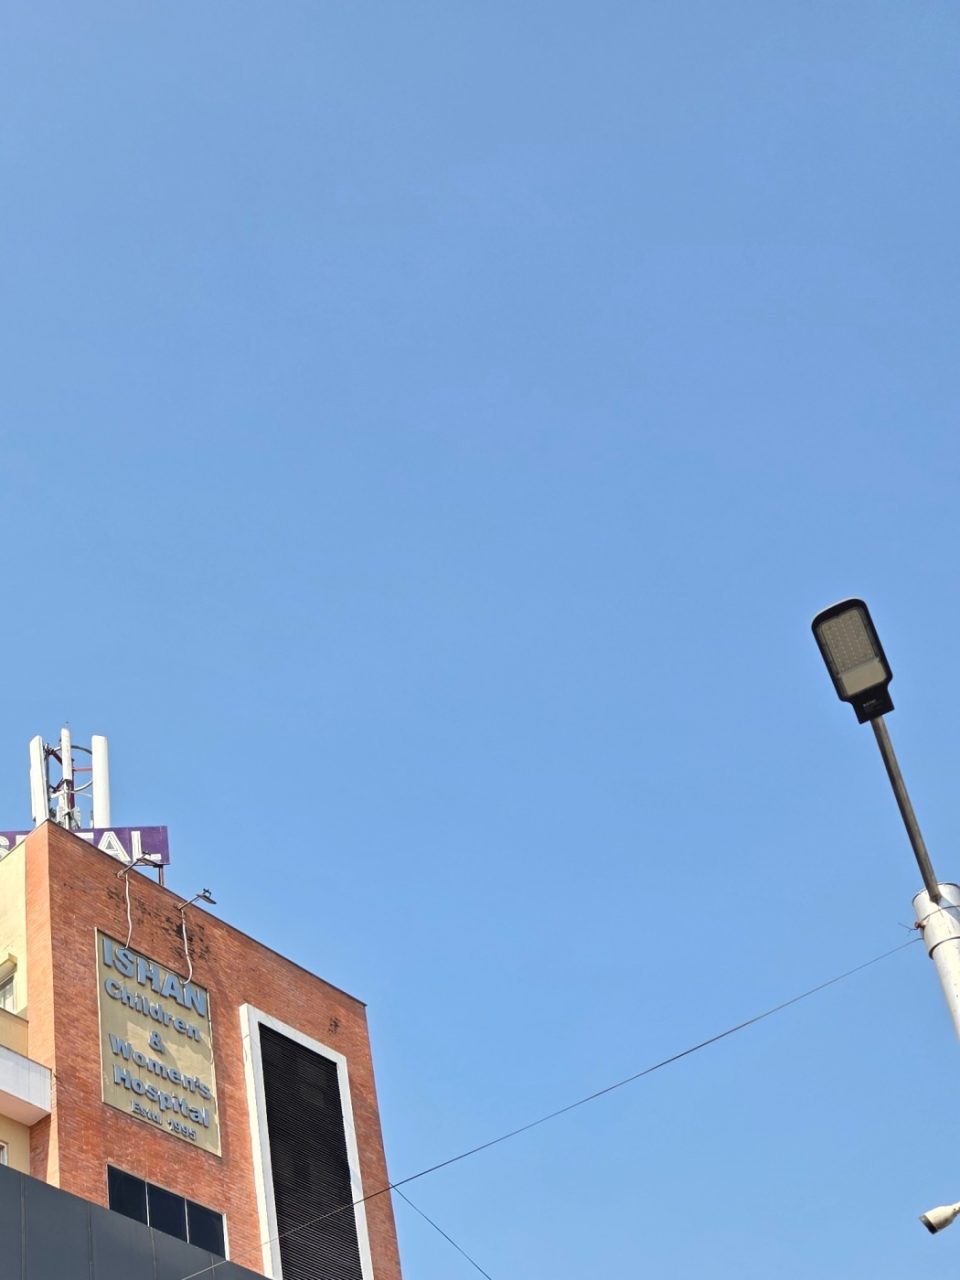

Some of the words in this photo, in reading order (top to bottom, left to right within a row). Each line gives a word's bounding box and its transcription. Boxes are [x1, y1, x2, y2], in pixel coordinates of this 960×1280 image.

[103, 938, 207, 1018] ISHAN
[104, 977, 201, 1042] Children
[108, 1033, 212, 1100] Women's
[147, 1030, 165, 1054] &
[113, 1063, 209, 1128] Hospital
[168, 1118, 197, 1140] 1995
